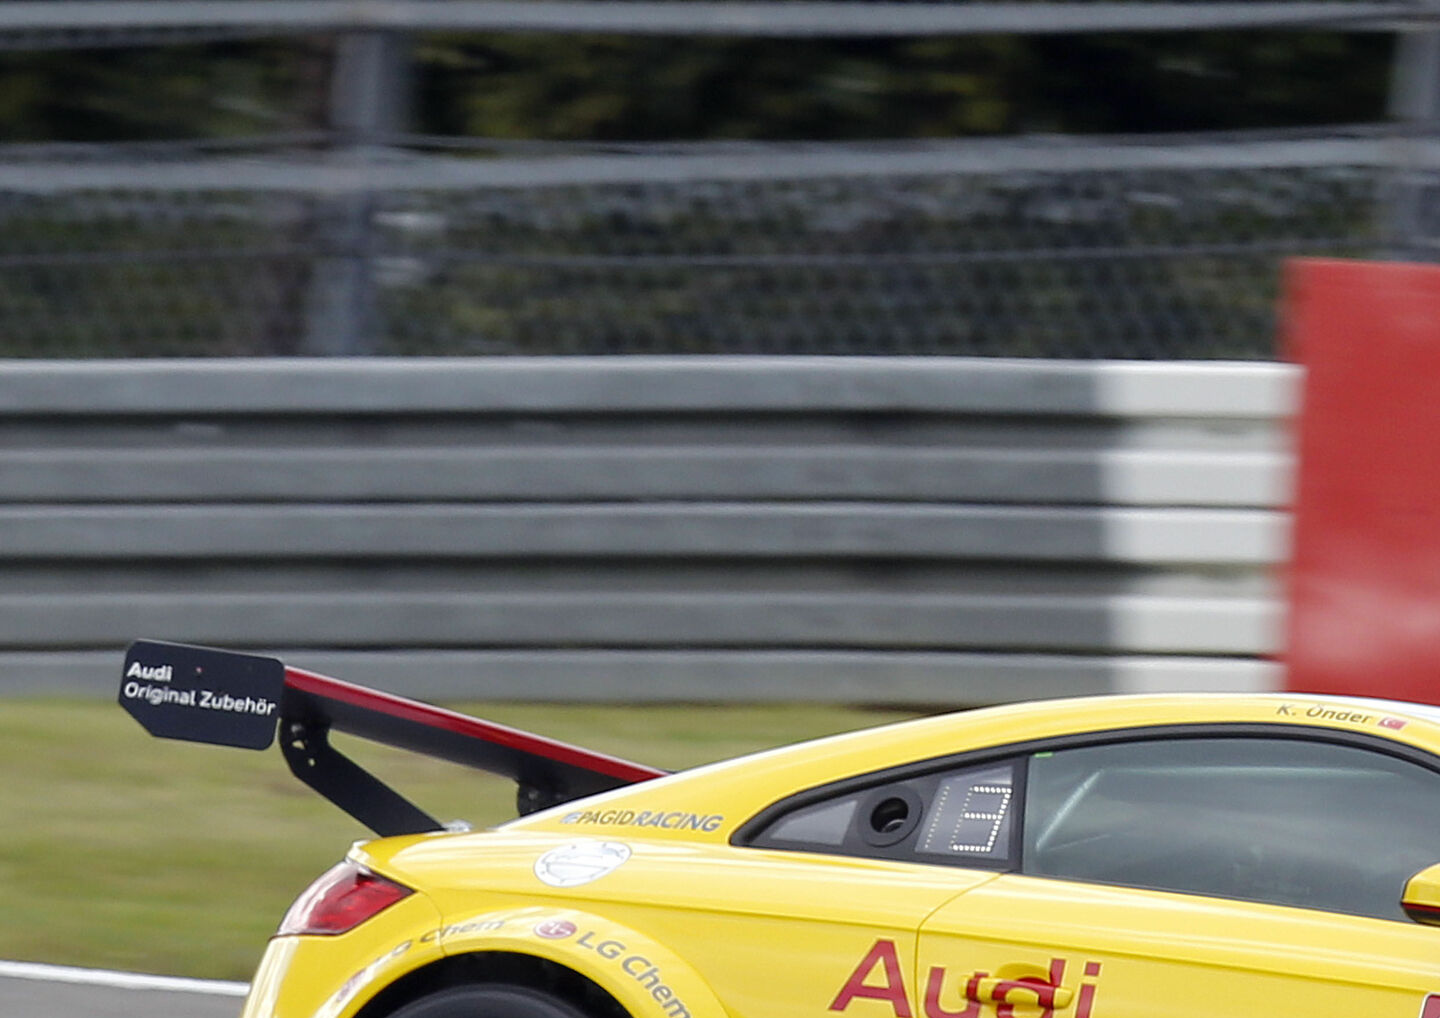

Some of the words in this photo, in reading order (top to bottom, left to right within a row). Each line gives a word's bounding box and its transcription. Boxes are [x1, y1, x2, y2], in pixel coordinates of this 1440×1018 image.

[127, 662, 173, 682] Audi
[124, 682, 196, 705] Original
[199, 691, 276, 716] Zubehör
[1276, 704, 1297, 717] K.
[576, 810, 724, 832] PAGIDRACING
[577, 931, 626, 960] LG
